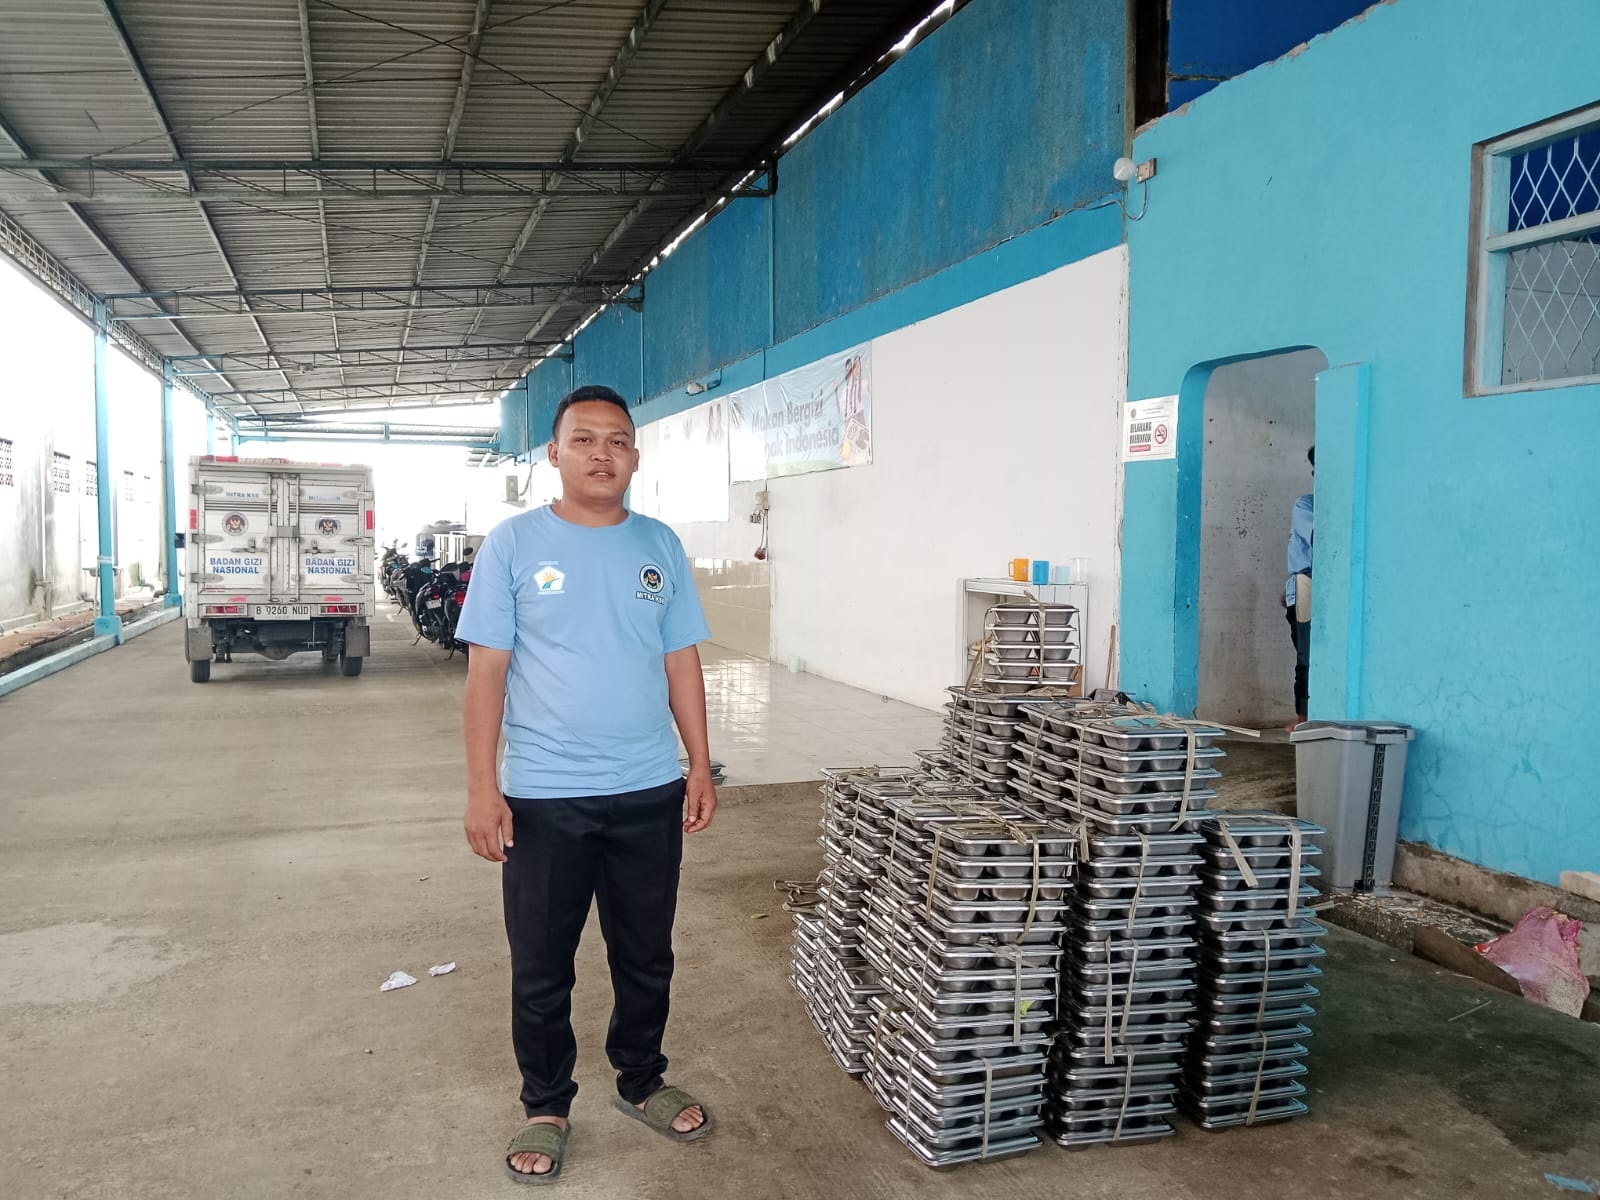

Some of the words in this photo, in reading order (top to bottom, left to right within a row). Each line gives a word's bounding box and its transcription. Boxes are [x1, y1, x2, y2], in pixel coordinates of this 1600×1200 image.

[752, 410, 784, 432] Makan
[787, 389, 823, 426] Bergizi
[1130, 422, 1152, 433] DILARANG
[764, 432, 783, 457] nak
[785, 420, 839, 454] Indonesia
[210, 557, 241, 566] BADAN
[243, 558, 262, 566] GIZI
[305, 558, 334, 566] BADAN
[337, 558, 355, 567] GIZI
[212, 566, 259, 574] NASIONAL
[308, 567, 352, 575] NASIONAL
[636, 592, 654, 601] MITRA
[256, 606, 261, 615] B
[265, 605, 288, 615] 9260
